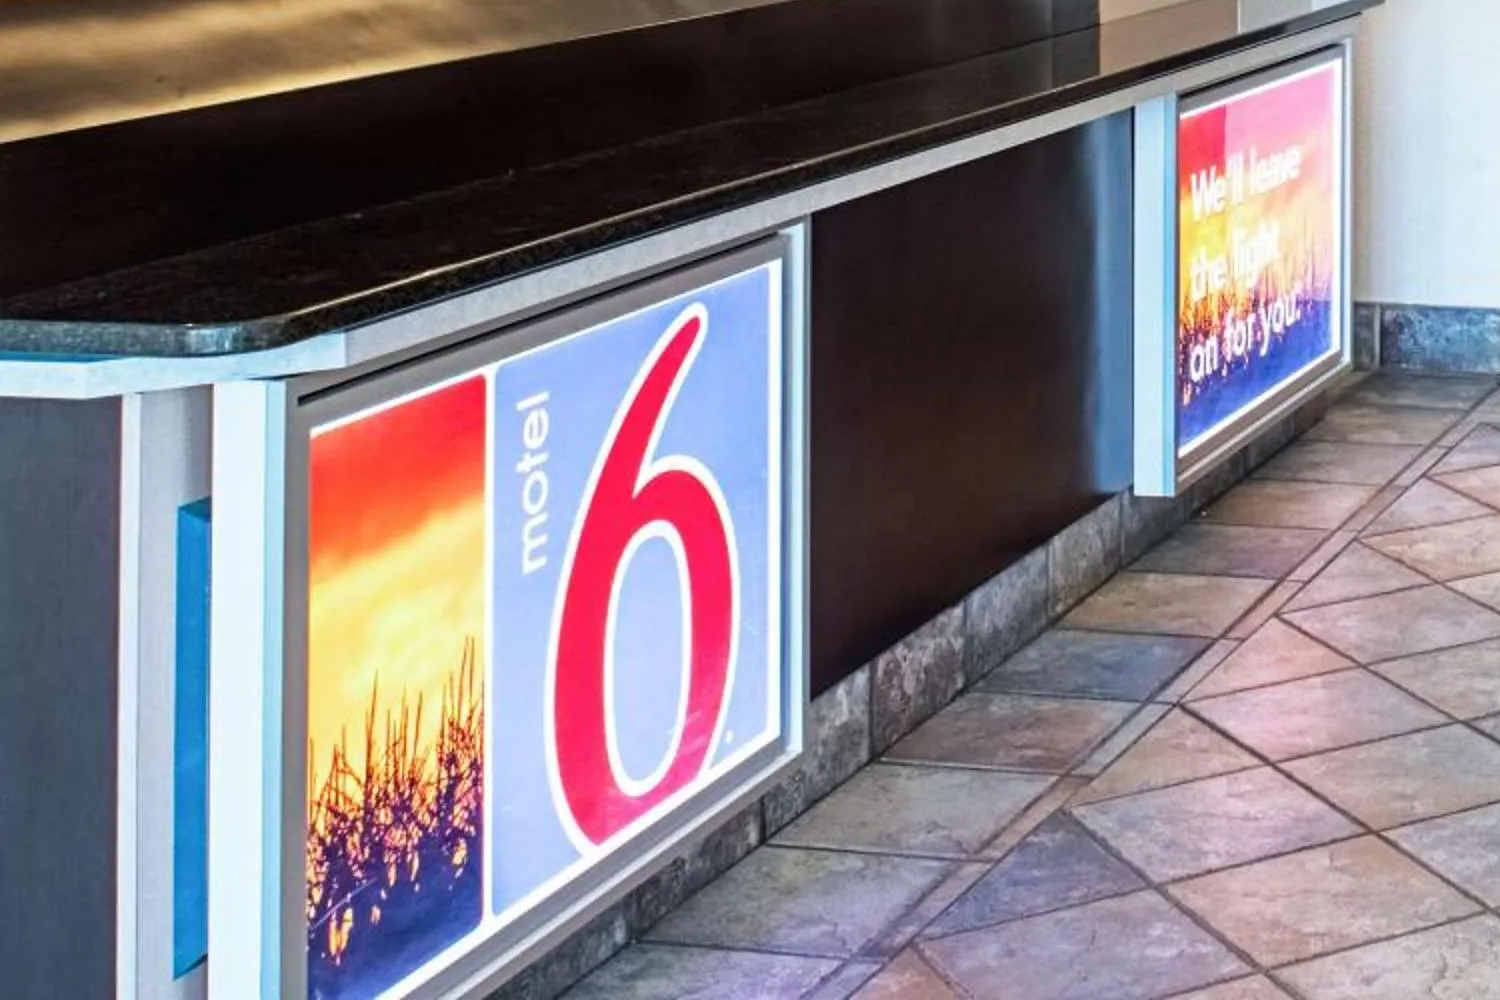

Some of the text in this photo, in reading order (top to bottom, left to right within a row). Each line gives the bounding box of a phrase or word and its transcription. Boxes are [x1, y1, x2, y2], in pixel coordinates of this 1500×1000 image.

[1190, 144, 1304, 222] We'll leave
[1190, 223, 1281, 302] the light
[1190, 335, 1219, 383] on
[1224, 308, 1255, 362] for
[515, 301, 743, 857] motel 6
